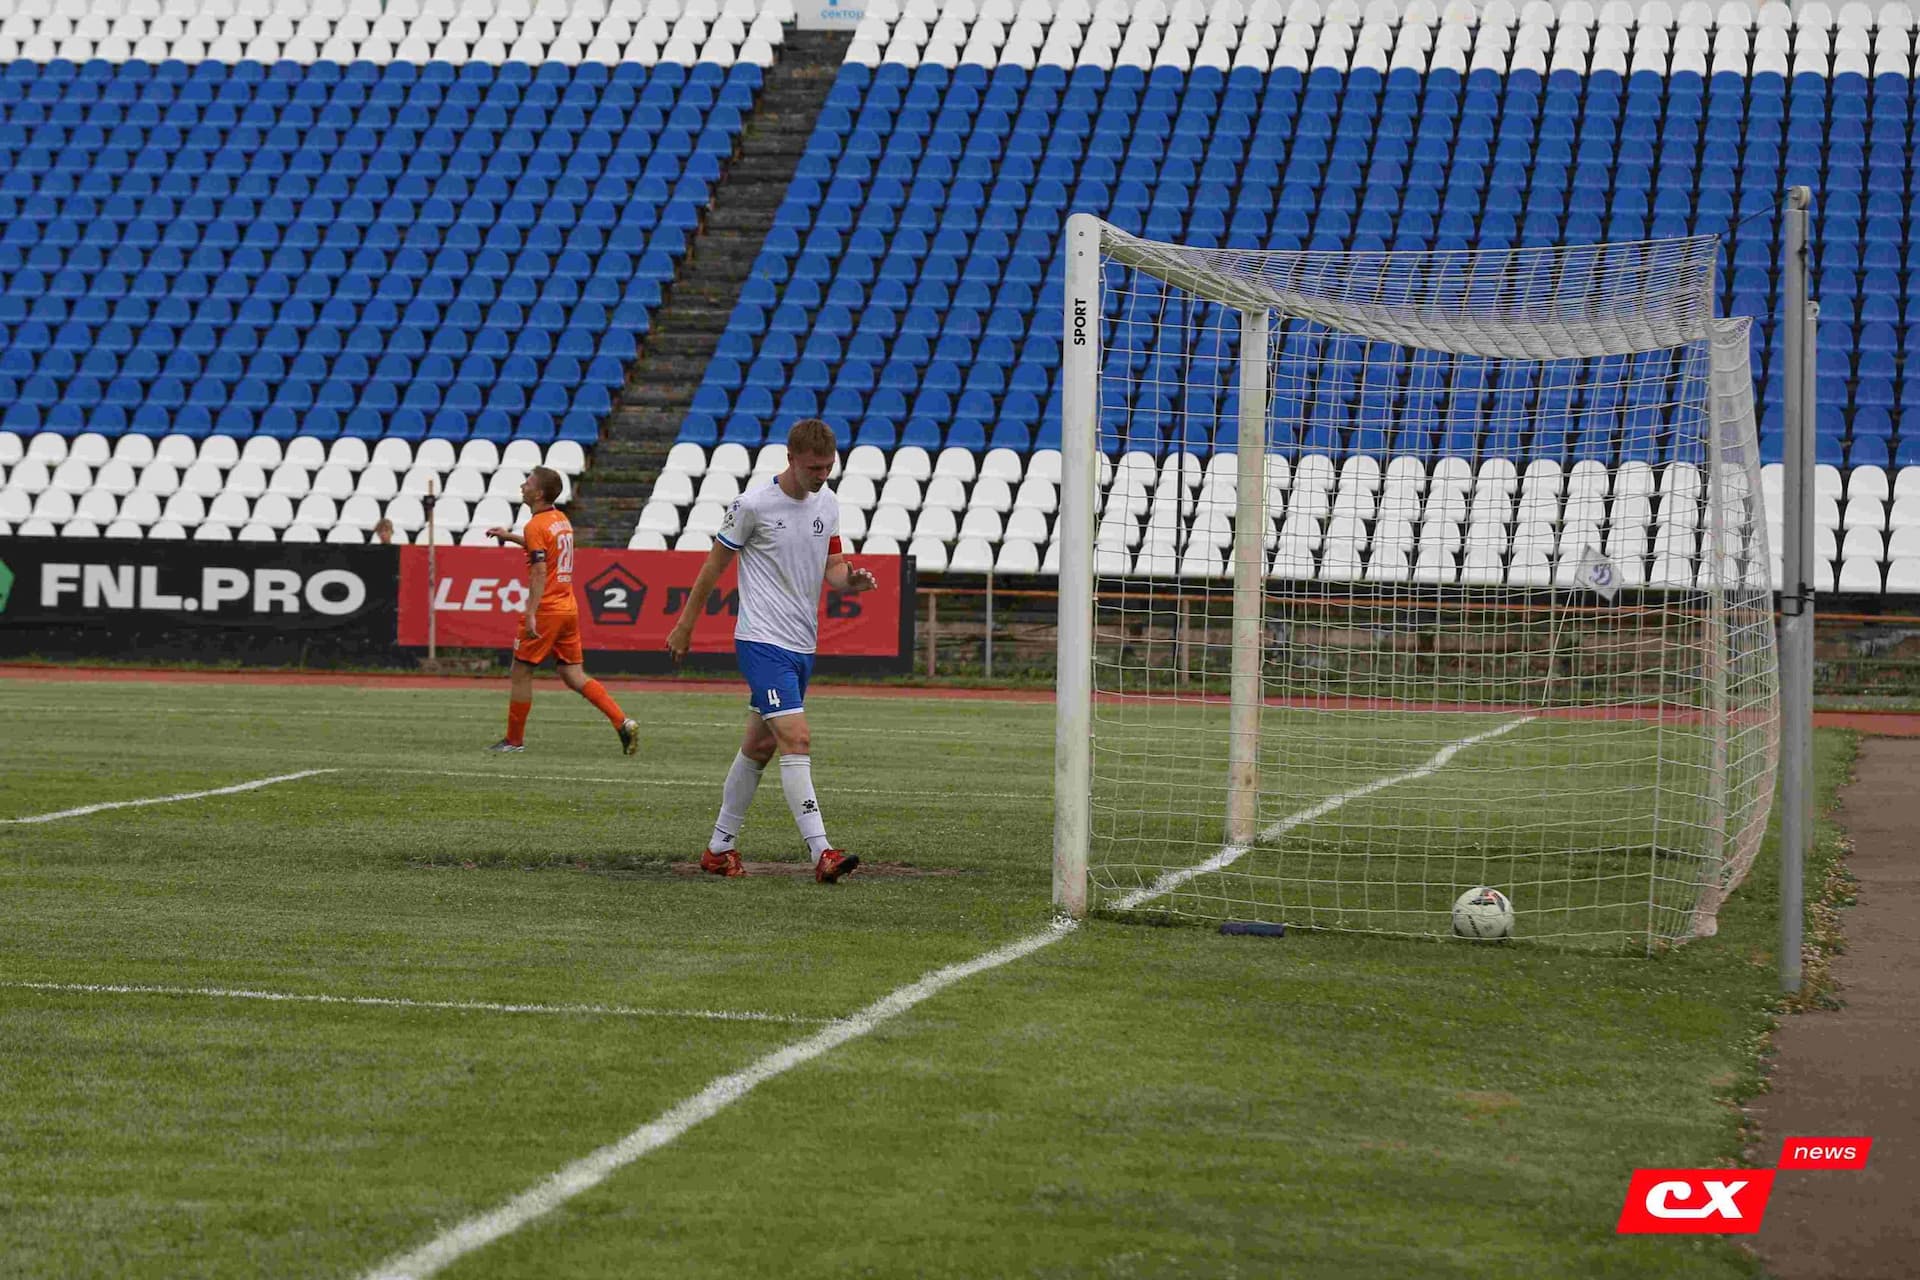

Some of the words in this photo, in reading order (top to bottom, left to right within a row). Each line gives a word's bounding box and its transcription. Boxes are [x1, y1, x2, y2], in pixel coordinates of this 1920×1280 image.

[1074, 298, 1086, 346] SPORT
[40, 563, 366, 616] FNL.PRO
[603, 588, 628, 608] 2
[767, 689, 780, 708] 4
